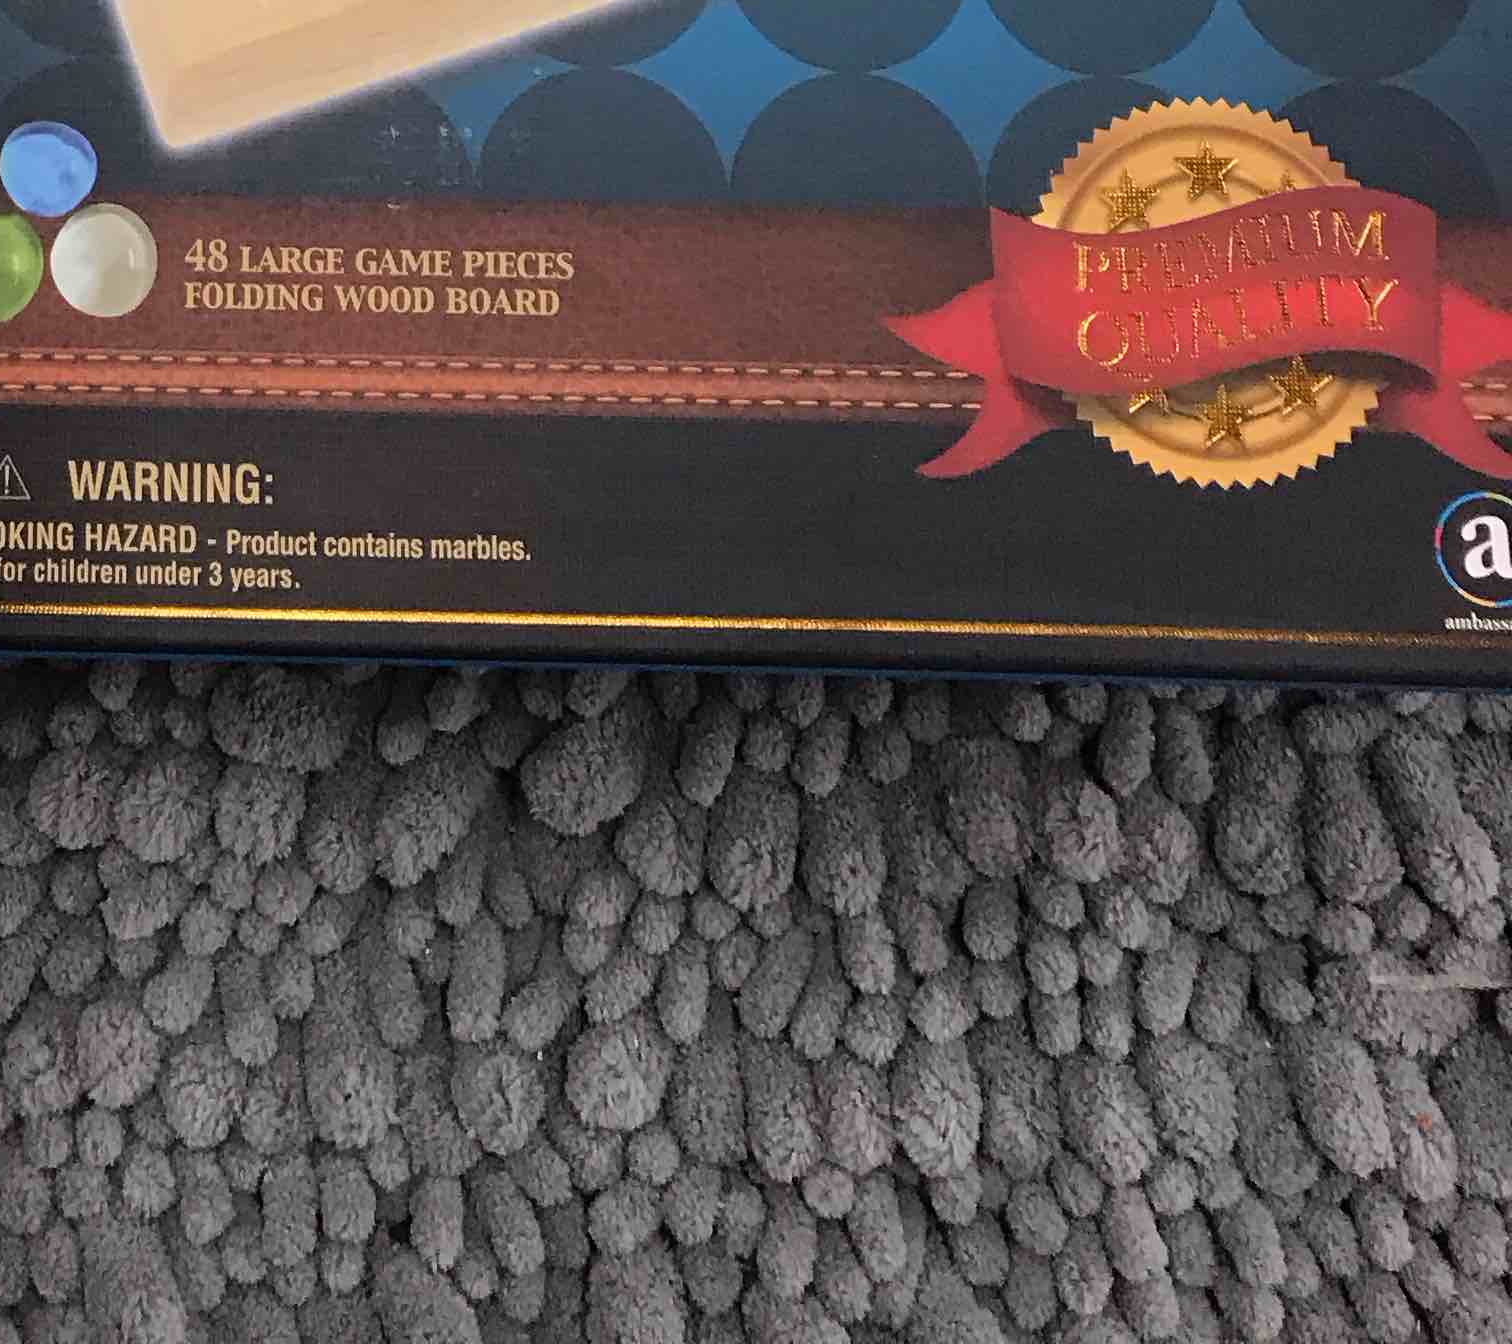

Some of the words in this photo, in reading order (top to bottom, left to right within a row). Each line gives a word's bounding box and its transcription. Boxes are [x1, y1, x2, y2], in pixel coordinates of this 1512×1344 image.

[184, 238, 229, 273] 48
[239, 245, 345, 275] LARGE
[354, 247, 453, 278] GAME
[462, 249, 576, 281] PIECES
[1073, 209, 1392, 294] PREMIUM
[184, 281, 323, 312] FOLDING
[334, 284, 435, 313] WOOD
[445, 286, 561, 316] BOARD
[1077, 275, 1400, 383] QUALITY
[68, 460, 274, 505] WARNING:
[85, 523, 198, 555] HAZARD
[225, 528, 318, 559] Product
[323, 531, 424, 561] contains
[430, 533, 532, 562] marbles.
[33, 558, 129, 585] children
[135, 560, 202, 587] under
[207, 562, 224, 587] 3
[230, 564, 301, 591] years.
